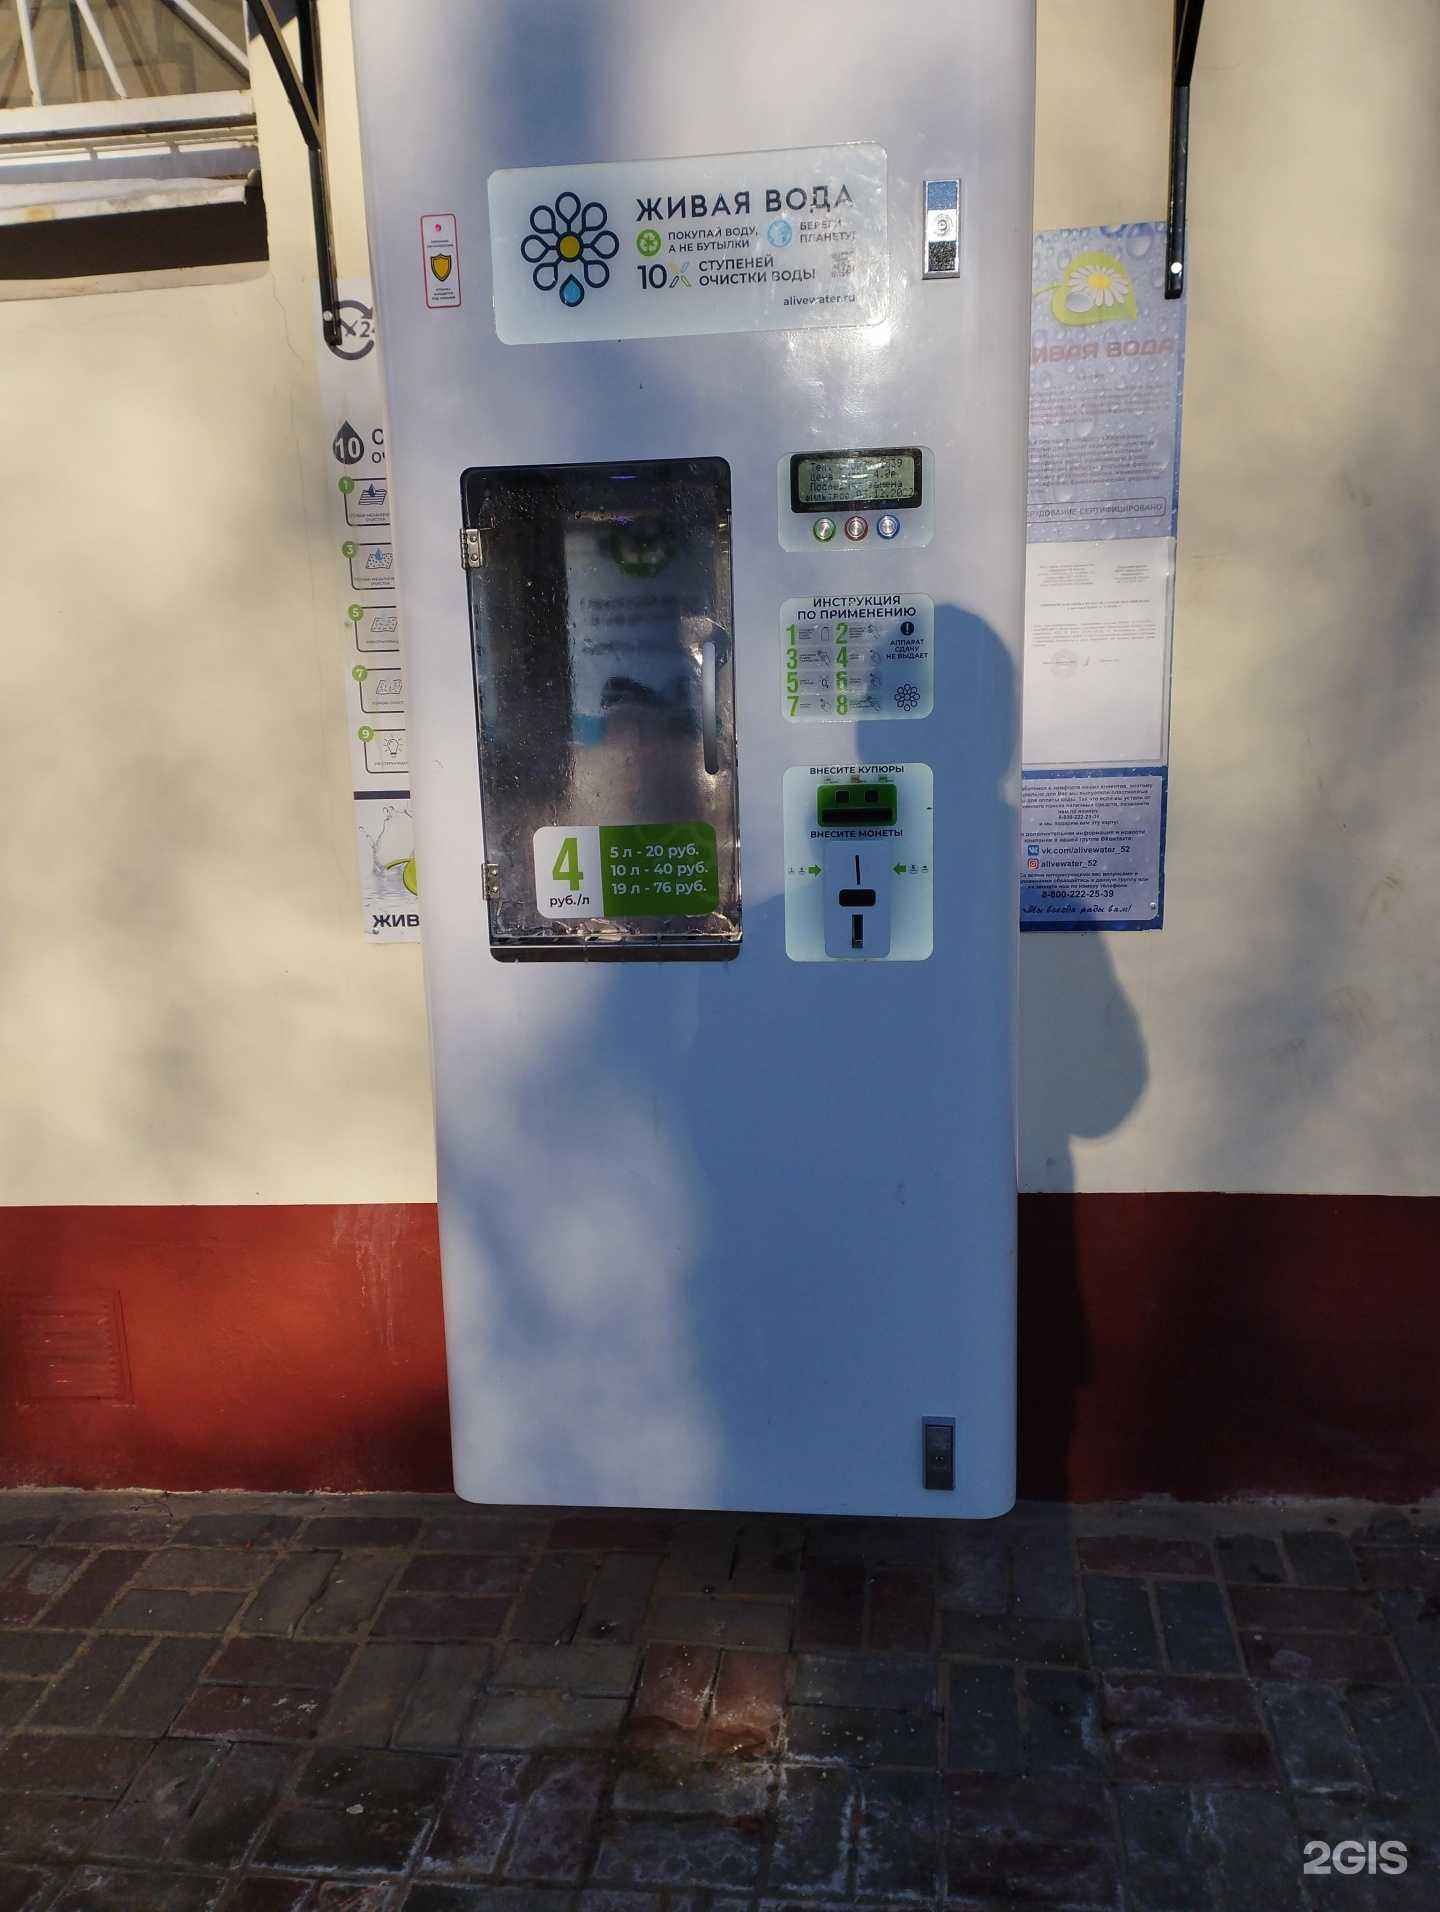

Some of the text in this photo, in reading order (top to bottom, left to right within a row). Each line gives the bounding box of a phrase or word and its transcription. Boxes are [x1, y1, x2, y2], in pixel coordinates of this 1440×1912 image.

[636, 184, 854, 221] ЖИВАЯ ВОДА
[668, 226, 758, 240] ПОКУПАЙ ВОДУ,
[668, 239, 750, 253] А НЕ БУТЫЛКИ
[698, 253, 774, 272] СТУПЕНЕЙ
[637, 263, 668, 289] 10
[698, 268, 816, 287] ОЧИСТКИ ВОДЫ
[335, 438, 360, 458] 10
[813, 595, 901, 607] ИНСТРУКЦИЯ
[797, 607, 916, 620] ПО ПРИМЕНЕНИЮ
[786, 624, 797, 645] 1
[836, 622, 848, 644] 2
[786, 647, 848, 669] 3 4
[786, 672, 798, 693] 5
[787, 696, 799, 716] 7
[836, 695, 848, 715] 8
[810, 765, 905, 774] ВНЕСИТЕ КУПЮРЫ
[810, 829, 903, 839] ВНЕСИТЕ МОНЕТЫ
[610, 847, 618, 858] 5
[621, 848, 632, 858] л
[646, 845, 663, 857] 20
[668, 843, 700, 858] руб.
[552, 837, 584, 891] 4
[610, 865, 626, 876] 10
[630, 866, 640, 876] л
[653, 863, 672, 875] 40
[677, 861, 708, 876] руб.
[611, 882, 626, 895] 19
[630, 884, 640, 894] л
[654, 881, 672, 893] 76
[676, 879, 707, 895] руб.
[1042, 889, 1114, 898] 8-800-222-25-39
[550, 893, 590, 908] руб./л
[372, 914, 420, 928] ЖИВ
